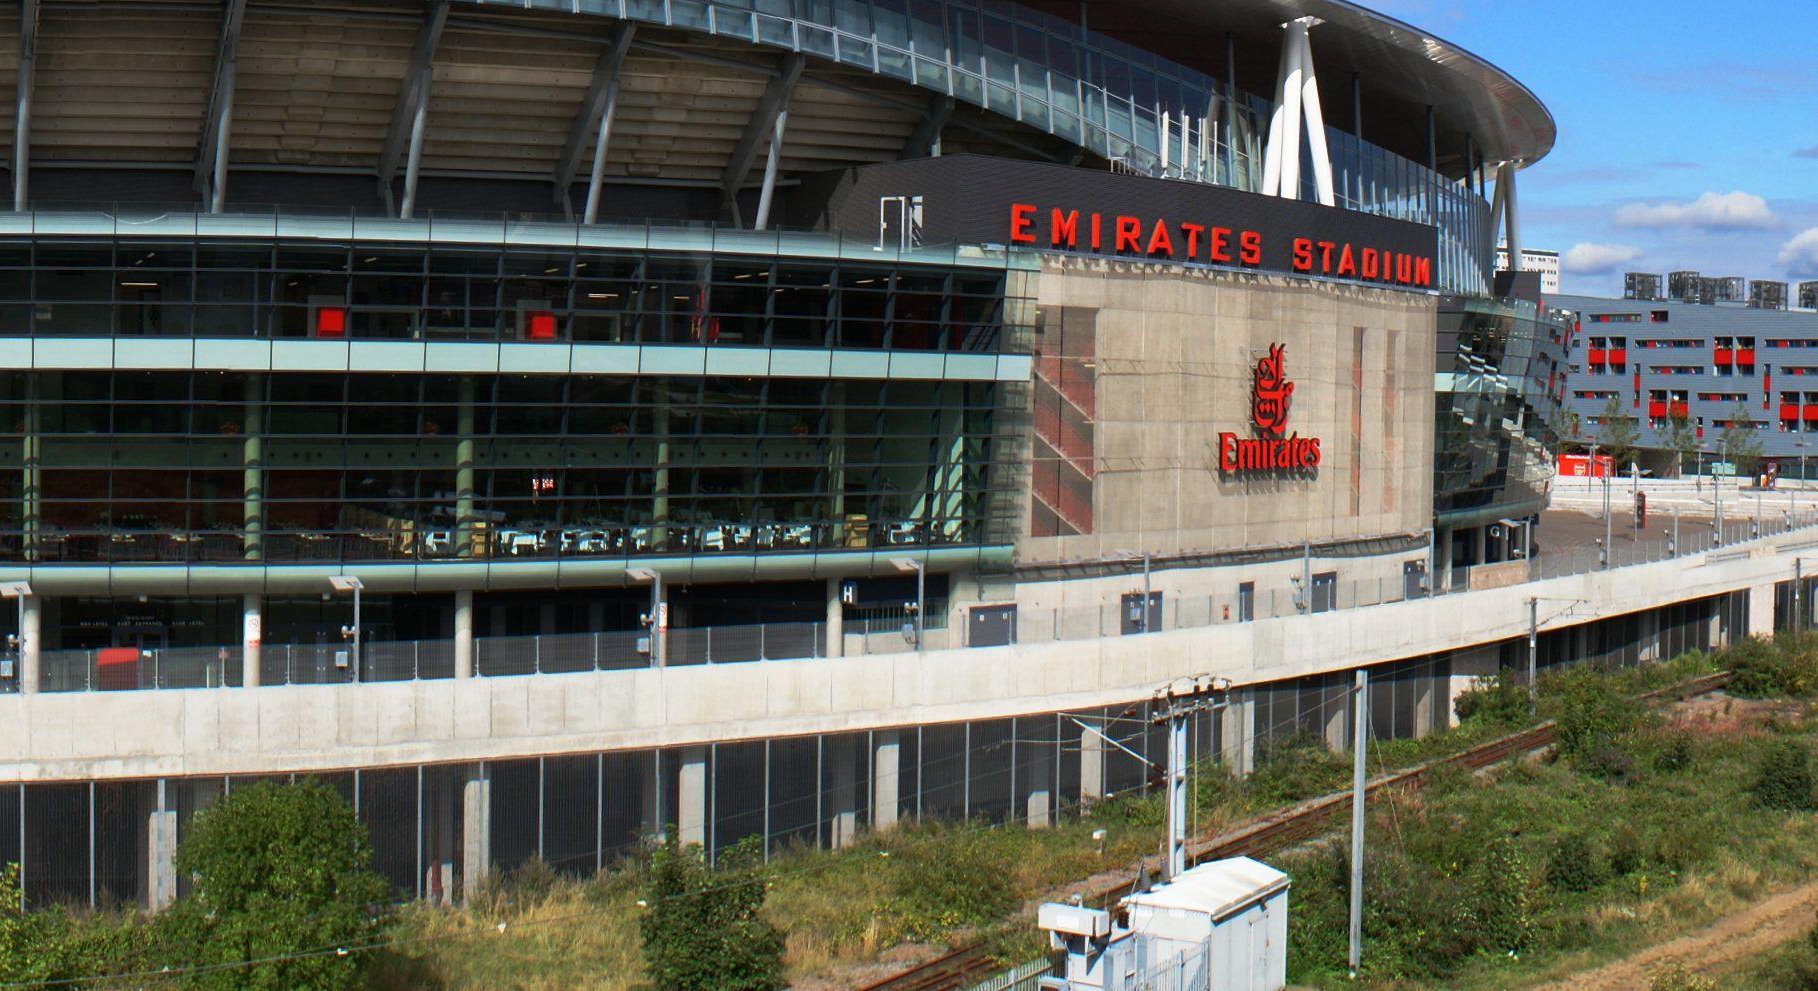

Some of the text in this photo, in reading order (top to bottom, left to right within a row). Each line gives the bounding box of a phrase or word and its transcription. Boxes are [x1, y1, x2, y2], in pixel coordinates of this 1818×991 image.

[1011, 203, 1431, 286] EMIRATES STADIUM
[1218, 431, 1321, 471] Emirates
[844, 586, 852, 603] H
